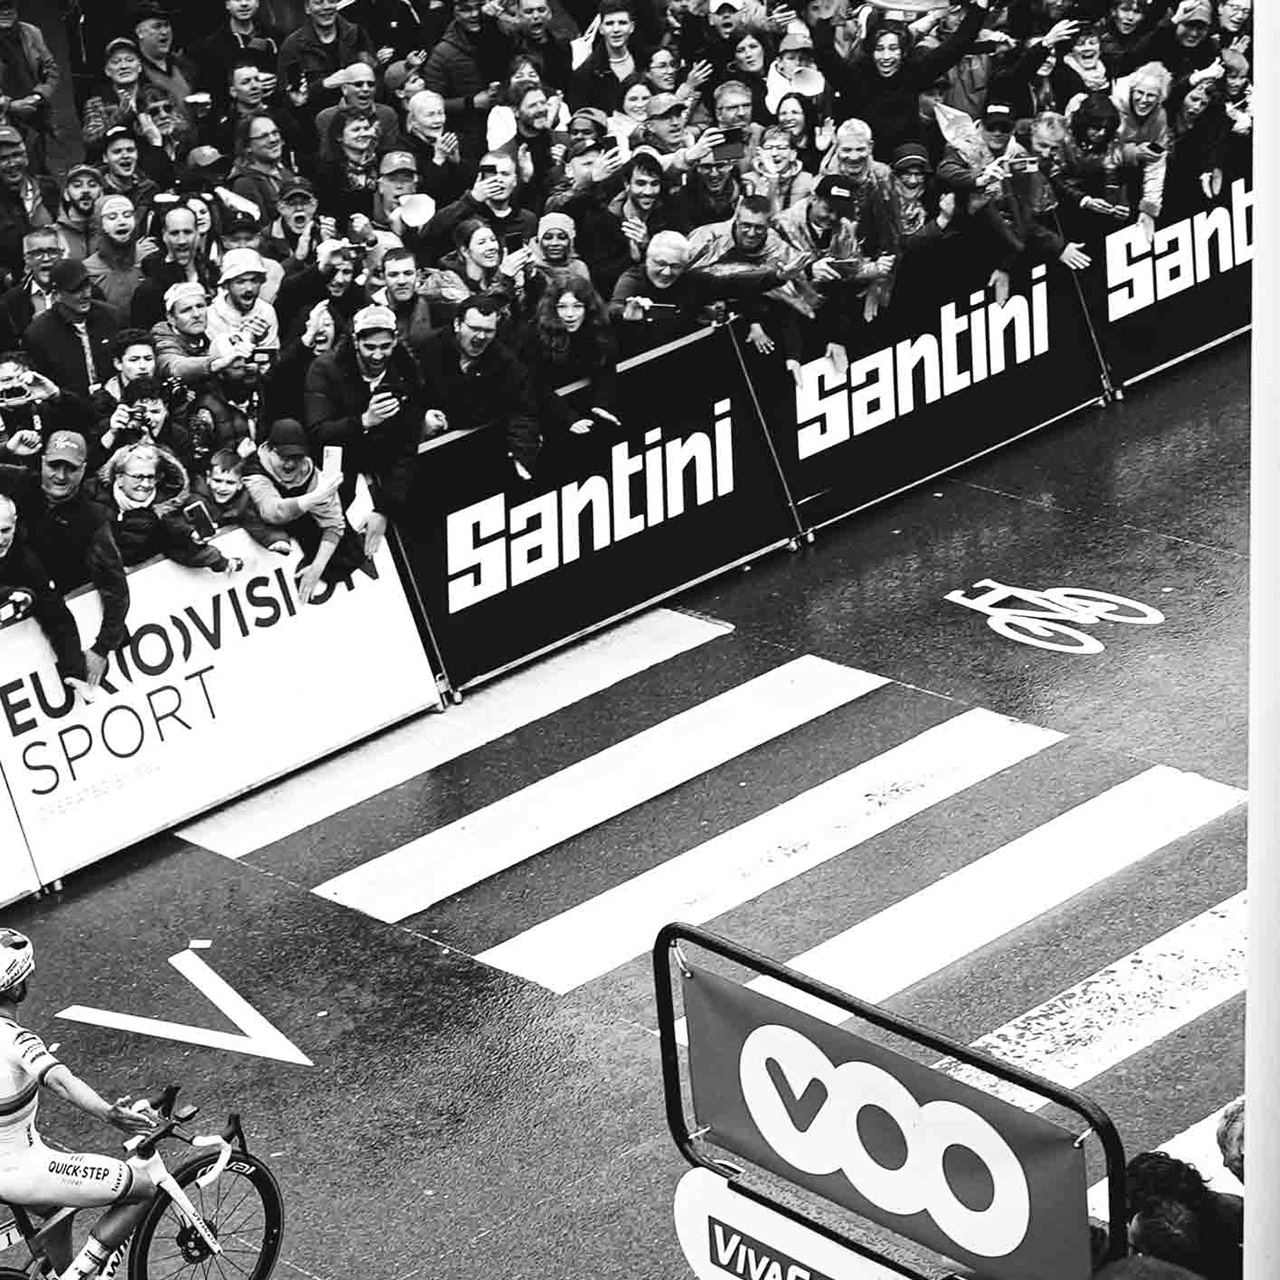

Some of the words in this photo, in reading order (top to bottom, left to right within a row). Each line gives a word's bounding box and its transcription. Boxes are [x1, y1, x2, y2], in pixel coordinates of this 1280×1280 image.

[797, 264, 1049, 460] Santini
[446, 399, 734, 614] Santini
[22, 665, 216, 795] SPORT
